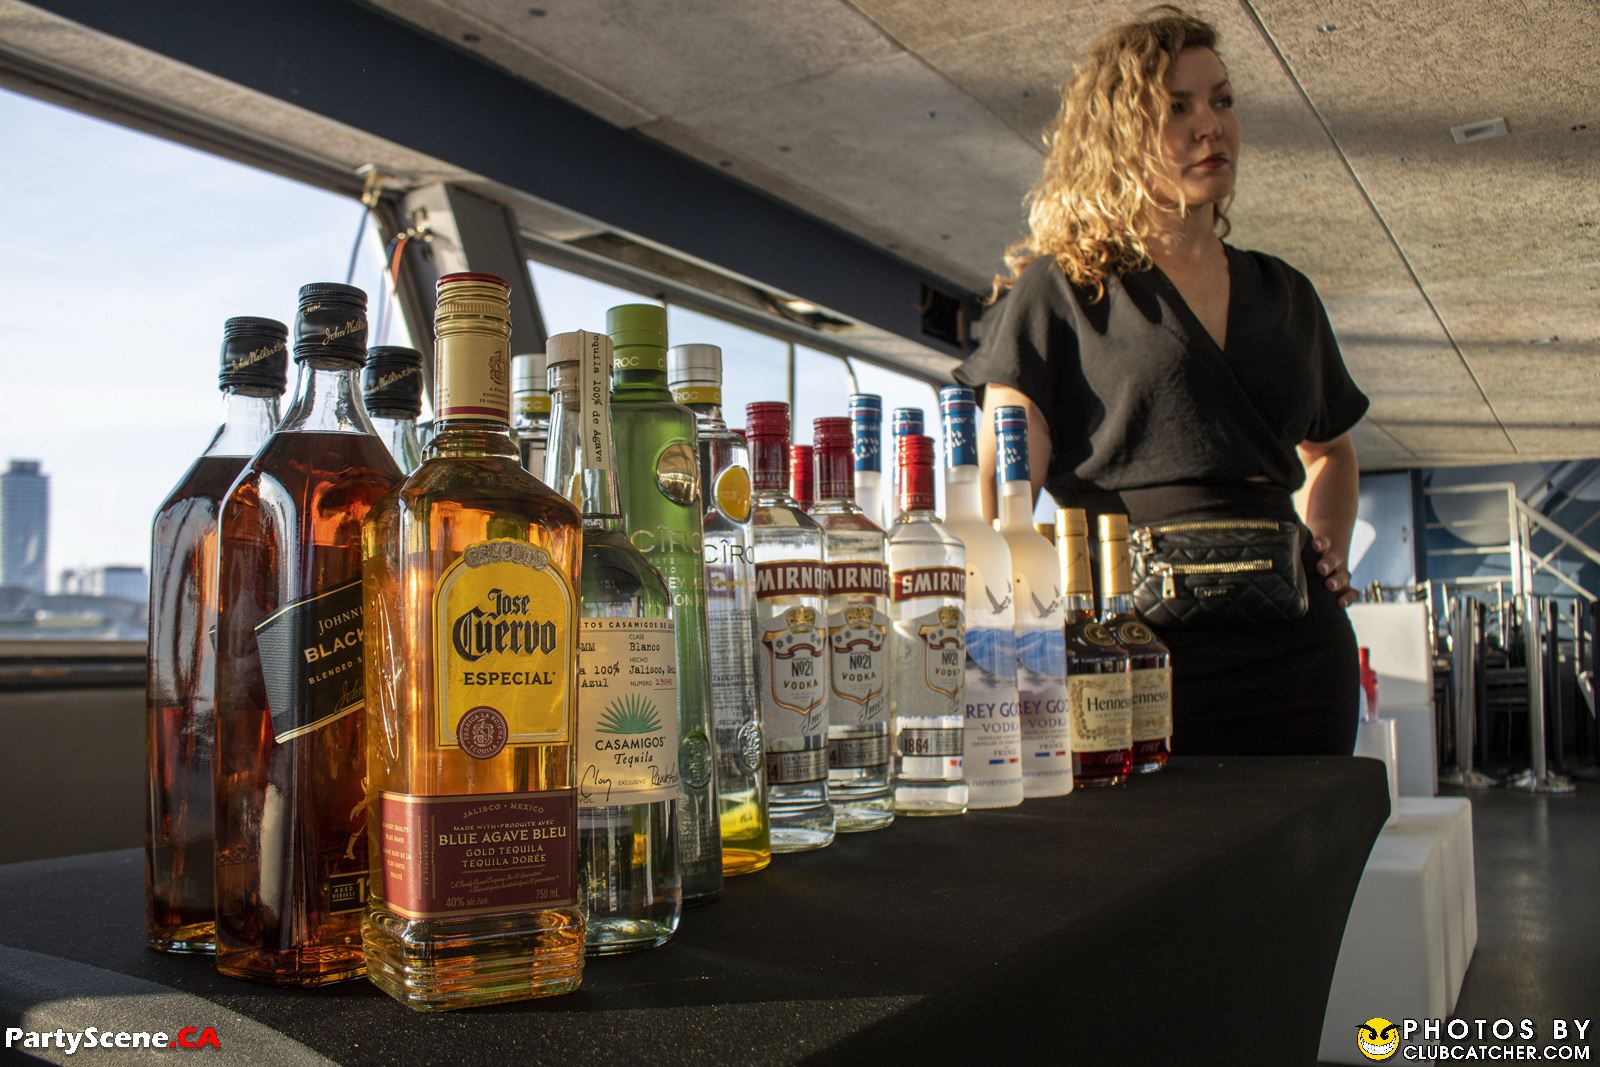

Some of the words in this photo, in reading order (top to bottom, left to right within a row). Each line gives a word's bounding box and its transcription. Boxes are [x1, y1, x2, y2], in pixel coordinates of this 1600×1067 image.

[592, 382, 603, 406] 100%
[592, 410, 602, 425] de
[592, 430, 603, 463] Agave
[488, 588, 531, 620] Jose
[608, 621, 658, 629] CASAMIGOS
[452, 606, 557, 663] Cuervo
[304, 629, 365, 664] BLACK
[628, 642, 661, 652] Blanco
[308, 661, 353, 685] BLENDED
[594, 661, 620, 677] 100%
[628, 665, 666, 676] Jalisco,
[842, 671, 877, 682] VODKA
[463, 671, 554, 686] ESPECIAL
[580, 678, 609, 688] Azul
[783, 679, 819, 690] VODKA
[965, 703, 996, 719] REY
[595, 736, 664, 751] CASAMIGOS
[903, 738, 929, 754] 1864
[613, 751, 654, 768] Tequila
[462, 803, 501, 819] JALISCO
[453, 824, 475, 832] MADE
[537, 819, 555, 827] AVEC
[438, 832, 478, 847] BLUE
[481, 830, 529, 844] AGAVE
[532, 826, 567, 840] BLEU
[465, 847, 495, 858] GOLD
[499, 844, 544, 855] TEQUILA
[462, 857, 509, 869] TEQUILA
[512, 853, 547, 865] DORÉE
[535, 888, 549, 900] 750
[445, 896, 465, 908] 40%
